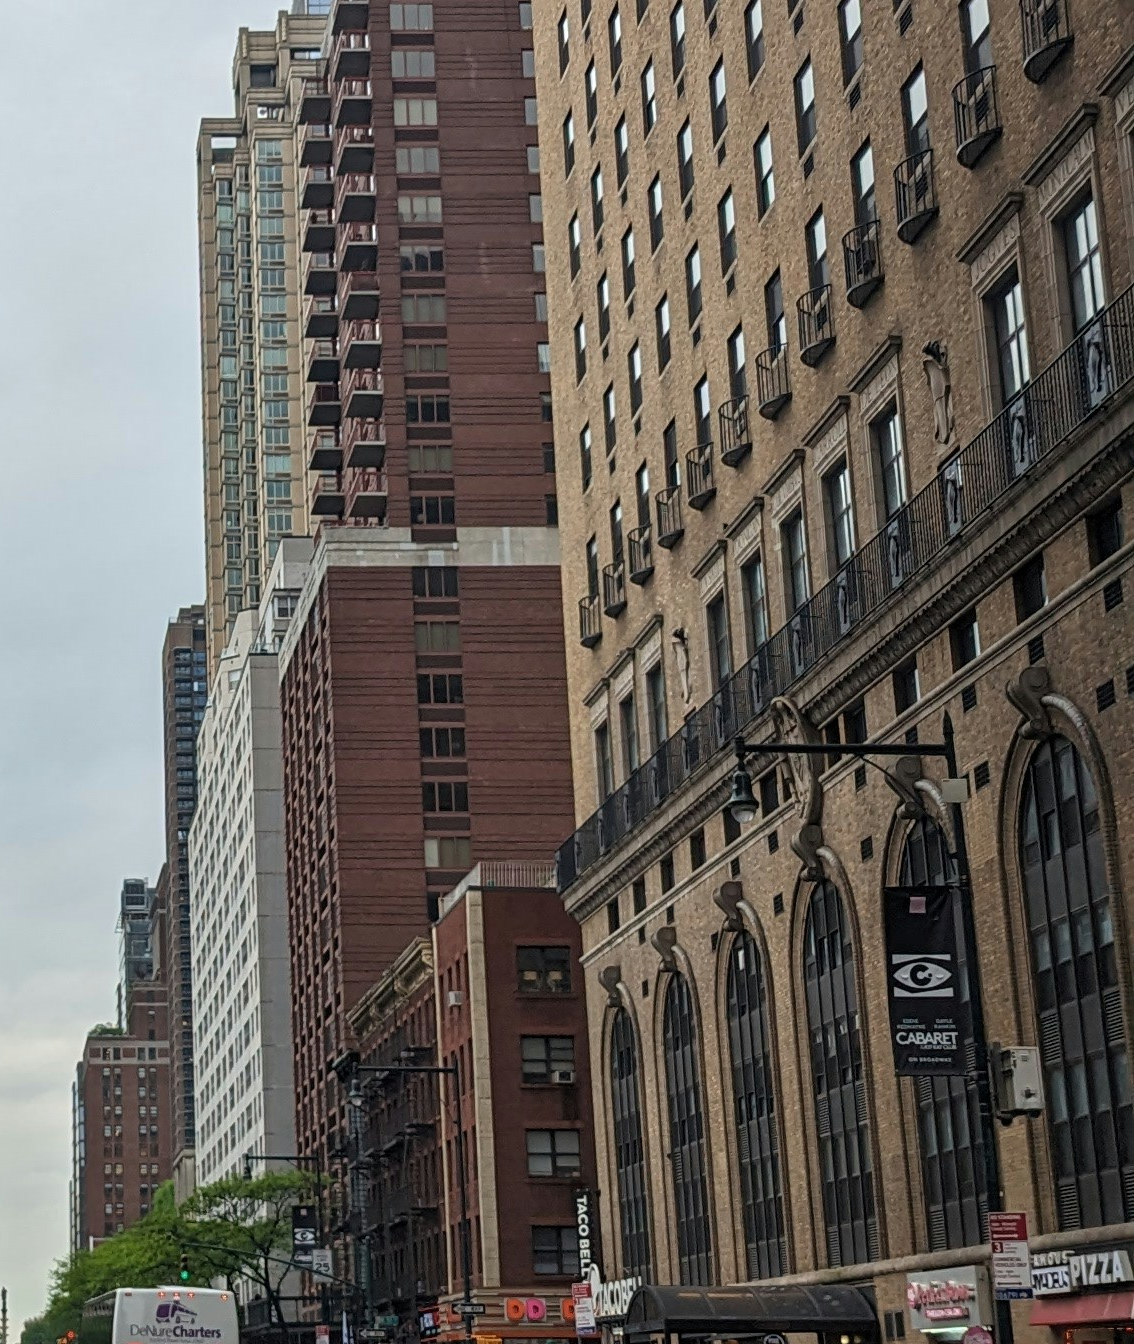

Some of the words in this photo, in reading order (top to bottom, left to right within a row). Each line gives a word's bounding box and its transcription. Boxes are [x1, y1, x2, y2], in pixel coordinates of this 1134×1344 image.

[896, 1031, 959, 1045] CABARET
[576, 1195, 589, 1237] TACO
[315, 1262, 330, 1272] 25
[579, 1238, 591, 1277] BELL
[1069, 1250, 1130, 1287] PIZZA
